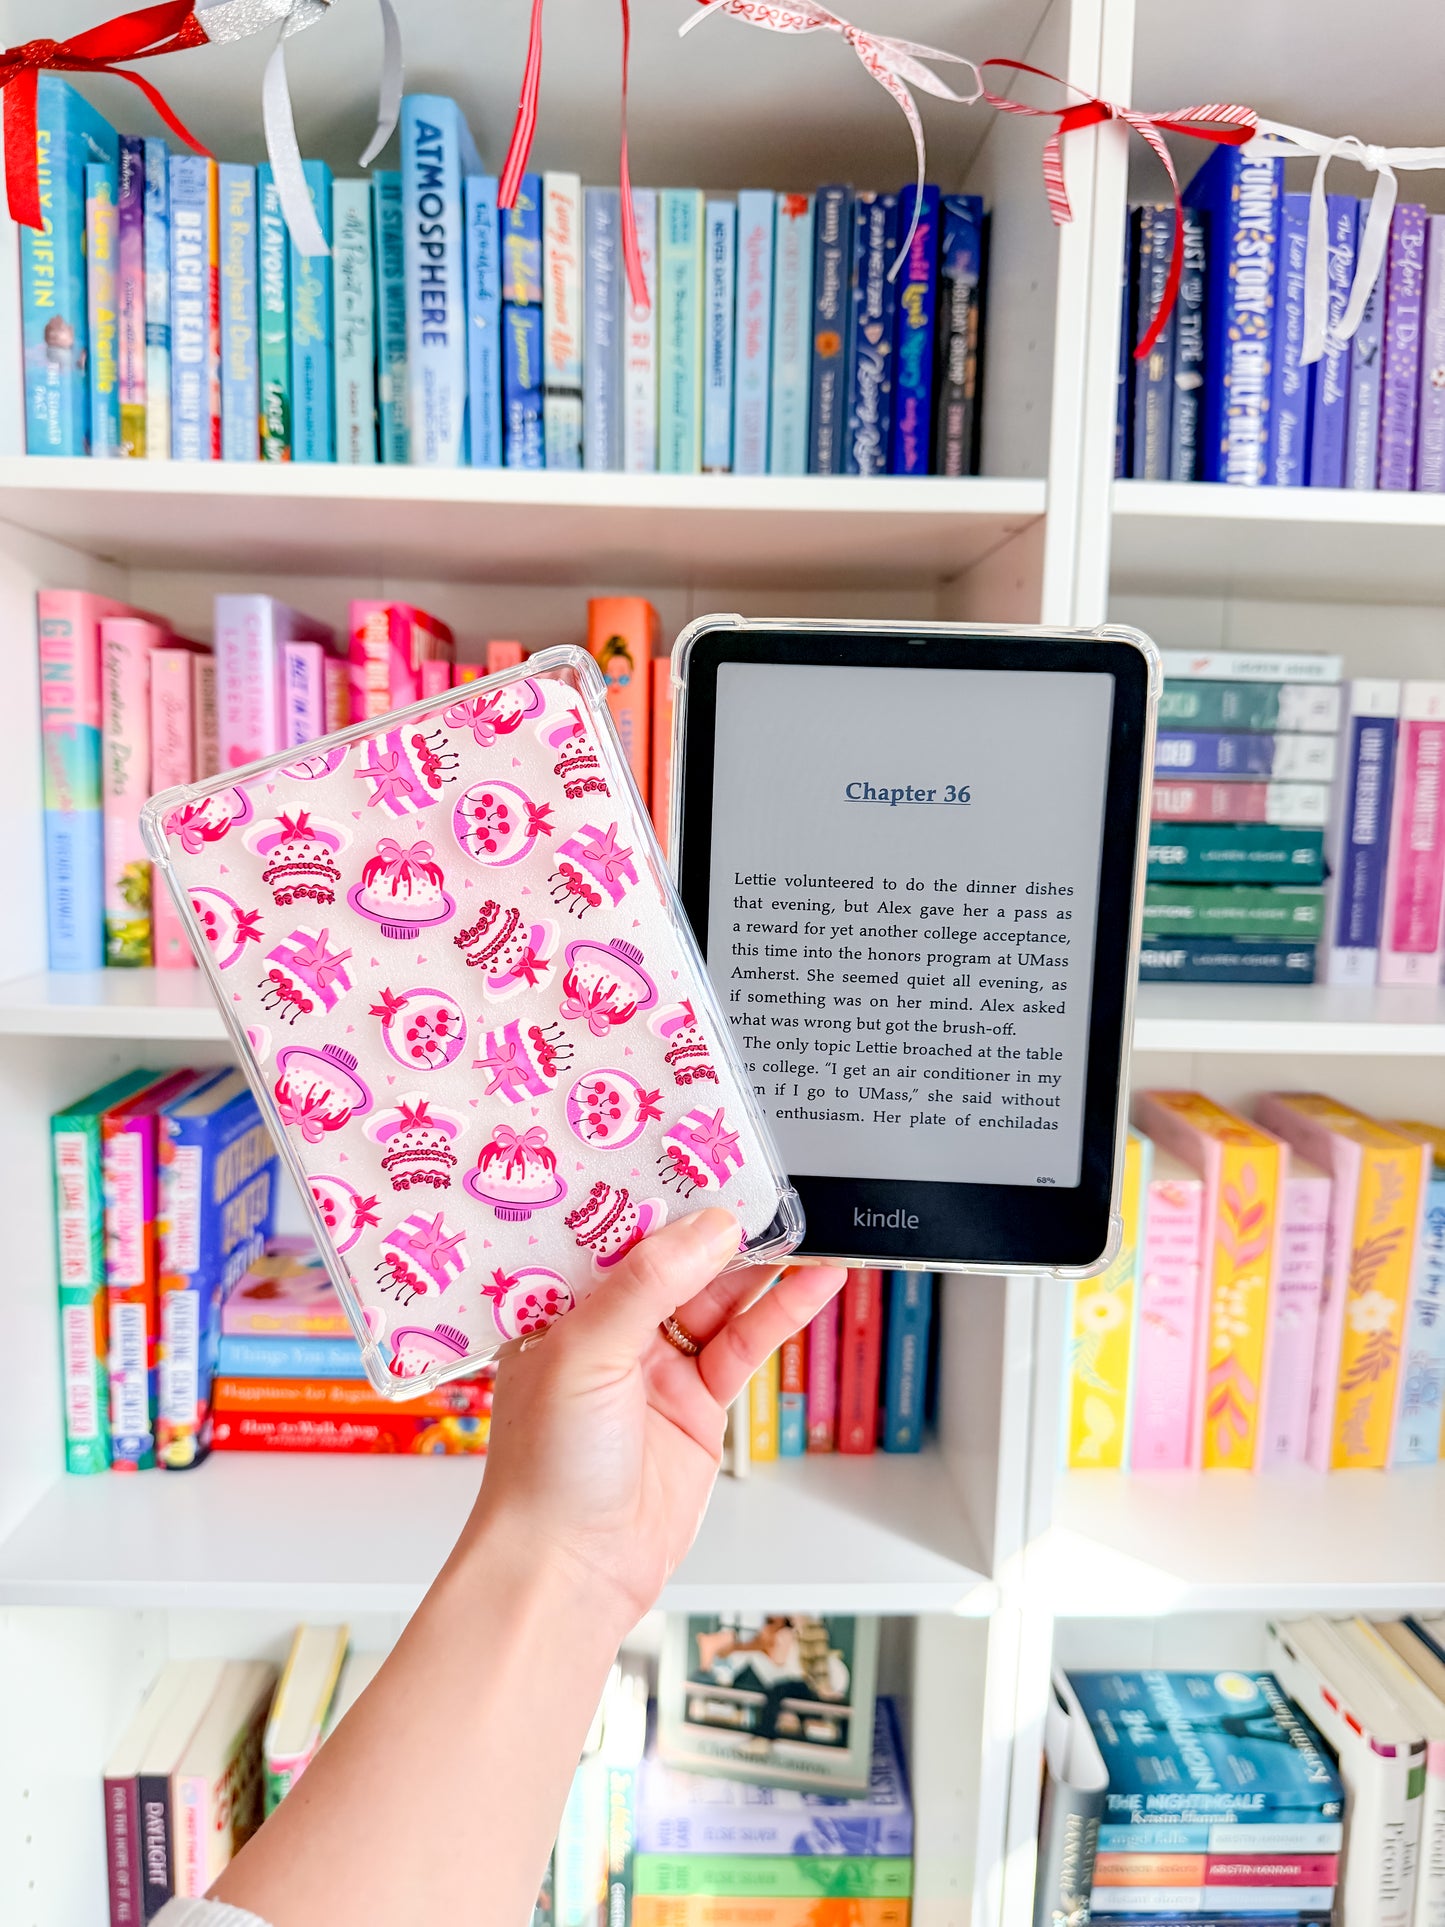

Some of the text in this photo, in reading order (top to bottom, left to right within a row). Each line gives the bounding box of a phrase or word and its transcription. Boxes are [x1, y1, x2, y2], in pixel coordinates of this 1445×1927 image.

[229, 181, 250, 217] The
[416, 119, 447, 347] ATMOSPHERE
[1183, 219, 1204, 271] JUST
[1234, 156, 1273, 315] FUNNY STORY
[176, 211, 202, 293] BEACH
[261, 217, 286, 313] LAYOVER
[819, 190, 844, 319] Funny Feelings
[225, 222, 250, 321] Roughest
[177, 300, 203, 363] READ
[1179, 315, 1202, 362] TYPE
[229, 326, 251, 380] Draft
[1229, 341, 1266, 406] EMILY
[40, 617, 76, 740] GUNCLE
[845, 782, 971, 806] Chapter 36
[734, 872, 1074, 897] Lettie volunteered to do the dinner dishes
[733, 895, 1073, 923] that evening, but Alex gave her a pass as
[732, 920, 1071, 947] a reward for yet another college acceptance,
[731, 942, 1069, 968] this time into the honors program at UMass
[730, 965, 1068, 994] Amherst. She seemed quiet all evening, as
[729, 988, 1066, 1015] if something was on her mind. Alex asked
[728, 1012, 1017, 1036] what was wrong but got the brush-off.
[742, 1035, 1063, 1061] The only topic Lettie broached at the table
[762, 1059, 819, 1078] college.
[842, 1064, 867, 1080] get
[872, 1067, 891, 1078] an
[896, 1065, 918, 1079] air
[923, 1066, 1011, 1082] conditioner
[1016, 1069, 1032, 1083] in
[1037, 1074, 1063, 1088] my
[774, 1082, 787, 1096] if
[793, 1083, 799, 1097] I
[806, 1087, 826, 1102] go
[834, 1086, 849, 1099] to
[927, 1088, 954, 1103] she
[962, 1091, 992, 1105] said
[1001, 1092, 1061, 1107] without
[775, 1106, 865, 1122] enthusiasm.
[872, 1110, 902, 1124] Her
[909, 1111, 947, 1129] plate
[954, 1113, 972, 1127] of
[978, 1115, 1059, 1131] enchiladas
[853, 1207, 919, 1229] kindle
[1106, 1793, 1266, 1812] THE NIGHTINGALE
[146, 1801, 168, 1887] DAYLIGHT
[1381, 1822, 1405, 1901] Picoult
